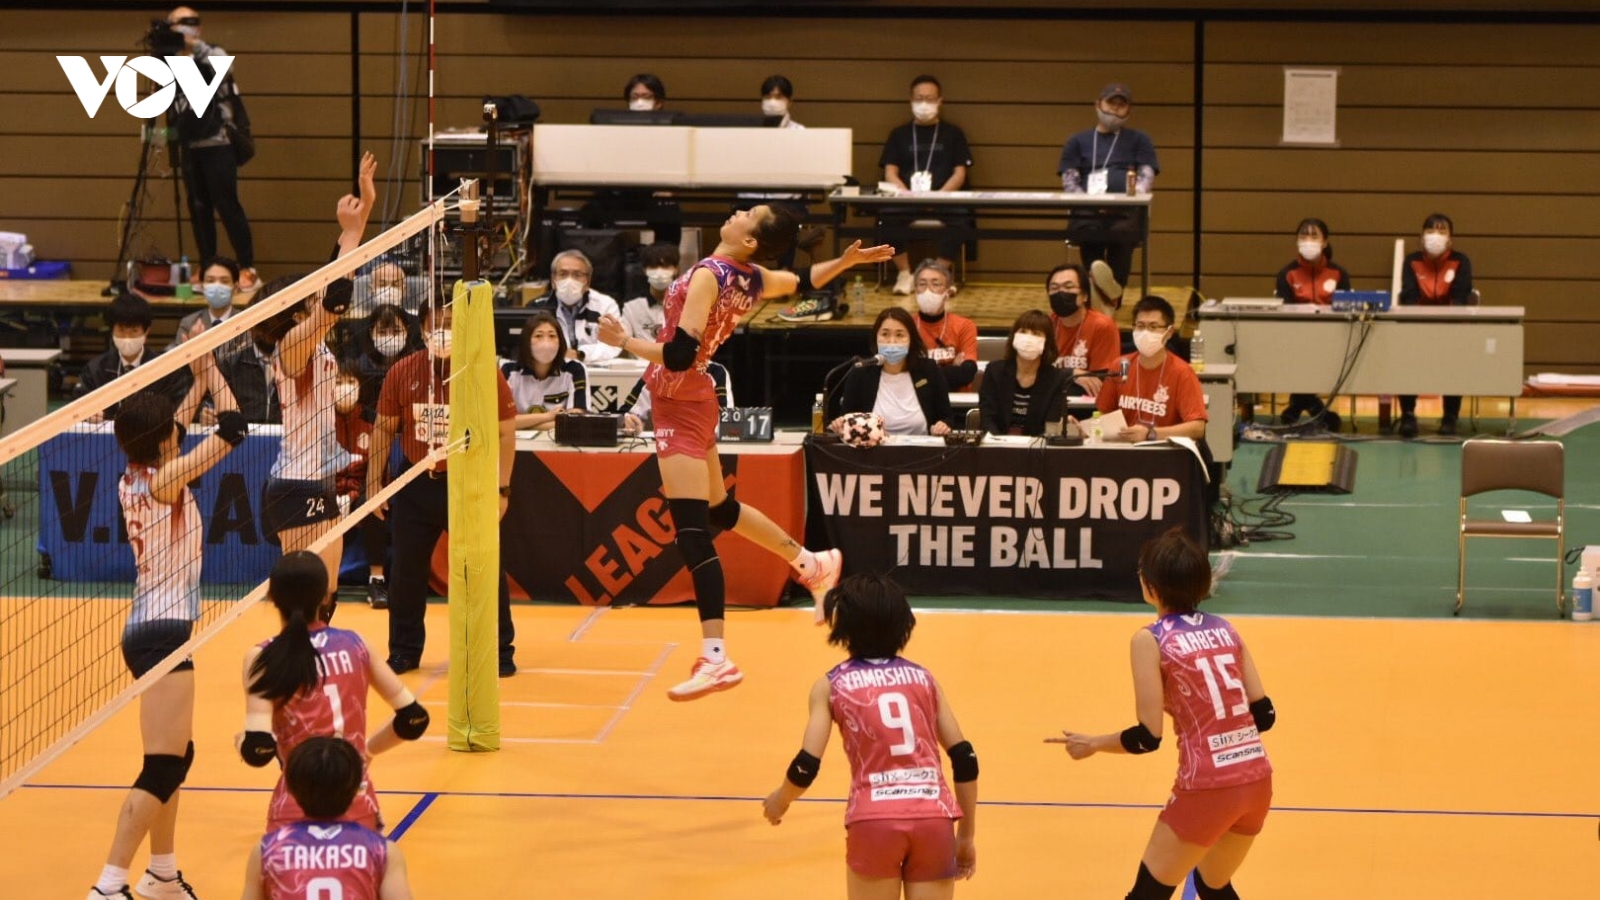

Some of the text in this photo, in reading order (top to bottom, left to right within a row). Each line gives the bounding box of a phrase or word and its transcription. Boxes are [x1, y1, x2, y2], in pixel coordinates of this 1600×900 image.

[1118, 395, 1167, 417] AIRYBEES
[747, 414, 770, 436] 17
[306, 497, 325, 518] 24
[816, 473, 1181, 521] WE NEVER DROP
[889, 525, 1103, 569] THE BALL
[1175, 627, 1235, 655] NABEYA
[841, 666, 929, 691] YAMASHITA
[1194, 653, 1249, 721] 15
[323, 683, 345, 740] 1
[877, 691, 916, 757] 9
[281, 844, 368, 871] TAKASO
